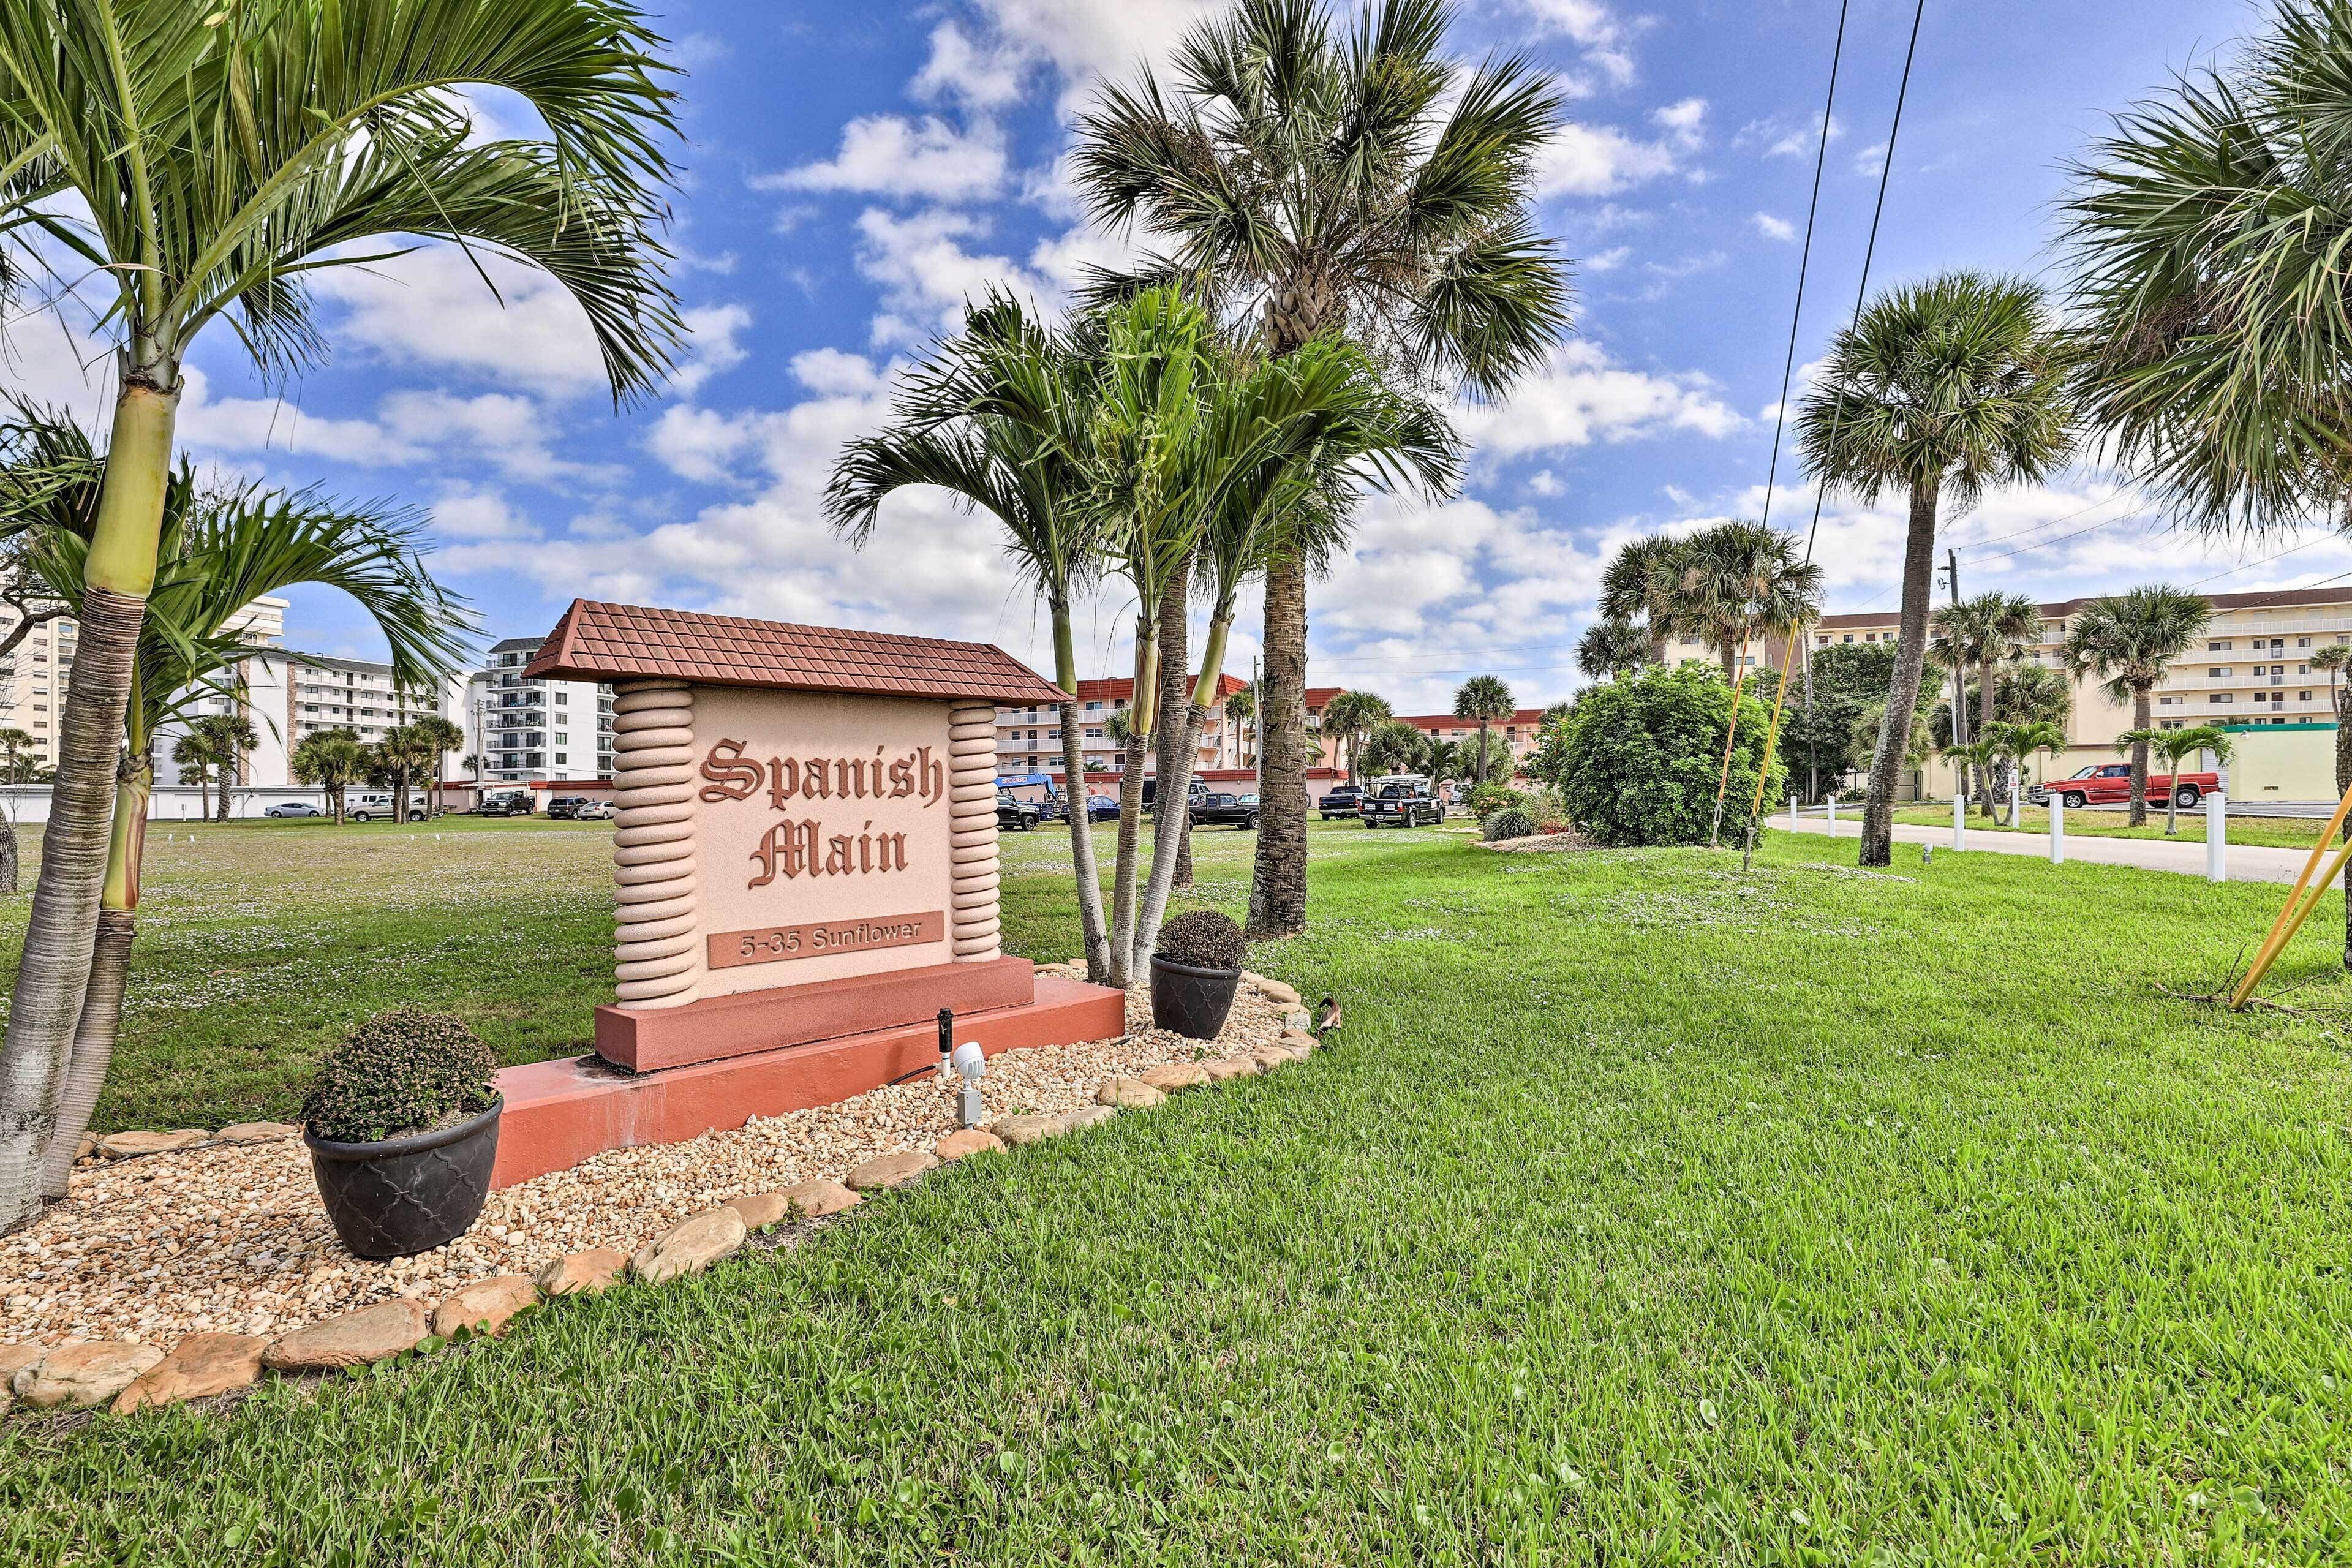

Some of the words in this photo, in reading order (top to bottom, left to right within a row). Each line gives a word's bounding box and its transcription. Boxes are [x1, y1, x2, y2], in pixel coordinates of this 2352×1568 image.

[699, 737, 943, 810] Spanish
[748, 818, 909, 889] Main
[740, 930, 802, 958] 5-35
[812, 922, 921, 949] Sunflower
